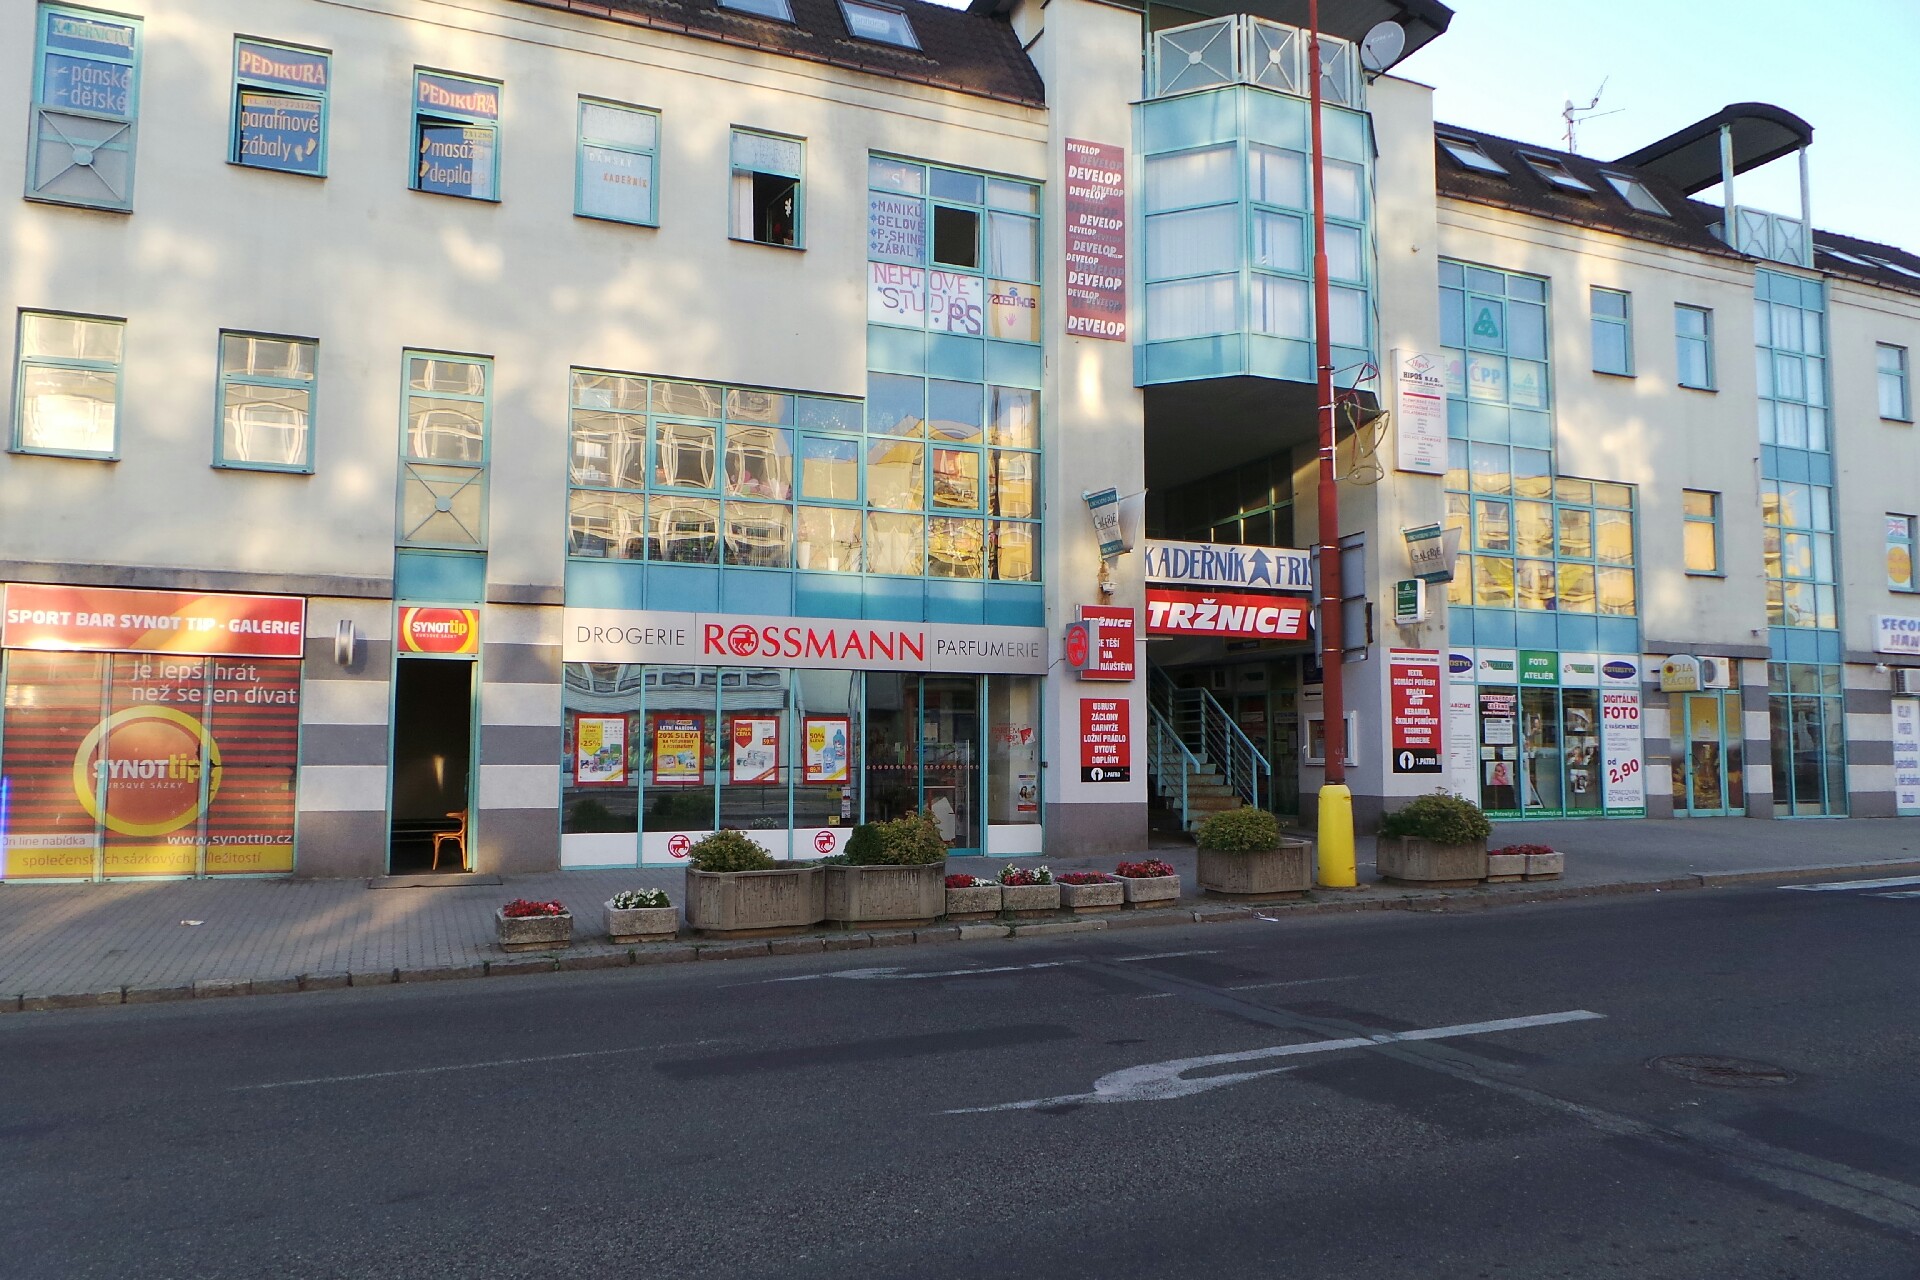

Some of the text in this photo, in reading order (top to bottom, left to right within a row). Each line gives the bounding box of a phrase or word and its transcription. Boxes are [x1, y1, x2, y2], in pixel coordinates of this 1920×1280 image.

[70, 82, 127, 111] dětské
[241, 107, 319, 133] parafínové
[240, 134, 292, 162] zábaly
[1067, 143, 1100, 155] DEVELOP
[1068, 165, 1122, 186] DEVELOP
[1069, 186, 1107, 200] DEVELOP
[1079, 213, 1123, 231] DEVELOP
[1069, 224, 1097, 236] DEVELOP
[1073, 240, 1117, 256] DEVELOP
[1066, 252, 1099, 265] DEVELOP
[1068, 271, 1122, 290] DEVELOP
[1067, 287, 1100, 300] DEVELOP
[1068, 315, 1125, 336] DEVELOP
[1403, 371, 1423, 381] HIPOS
[1145, 545, 1247, 582] KADEŘNÍK
[8, 608, 70, 626] SPORT
[75, 612, 115, 628] BAR
[120, 614, 181, 630] SYNOT
[186, 617, 216, 632] TIP
[229, 618, 300, 635] GALERIE
[1148, 598, 1302, 634] TRŽNICE
[412, 619, 468, 635] SYNOTtip
[577, 625, 686, 647] DROGERIE
[703, 623, 925, 662] ROSSMANN
[936, 638, 1040, 659] PARFUMERIE
[1106, 638, 1120, 648] TĚŠÍ
[1103, 650, 1113, 659] NA
[1100, 661, 1133, 672] NÁVŠTĚVU
[1529, 658, 1549, 666] FOTO
[1675, 663, 1693, 672] DIA
[159, 661, 209, 683] lepší
[214, 663, 261, 683] hrát,
[1524, 671, 1554, 680] ATELIÉR
[1664, 676, 1696, 685] RACIO
[132, 684, 297, 706] než se jen dívat
[1603, 693, 1638, 703] DIGITÁLNÍ
[1092, 702, 1117, 710] UBRUSY
[1603, 706, 1638, 719] FOTO
[1091, 712, 1118, 721] ZÁCLONY
[1091, 723, 1119, 732] GARNYŽE
[1083, 733, 1126, 743] LOŽNÍ PRÁDLO
[1094, 744, 1117, 754] BYTOVÉ
[1091, 754, 1119, 764] DOPLŇKY
[1415, 757, 1436, 766] 1.PATRO
[1608, 758, 1617, 766] od
[1609, 759, 1639, 784] 2,90
[20, 836, 39, 846] line
[42, 835, 86, 846] nabídka
[22, 853, 119, 868] společenskch
[123, 852, 190, 867] sázkových
